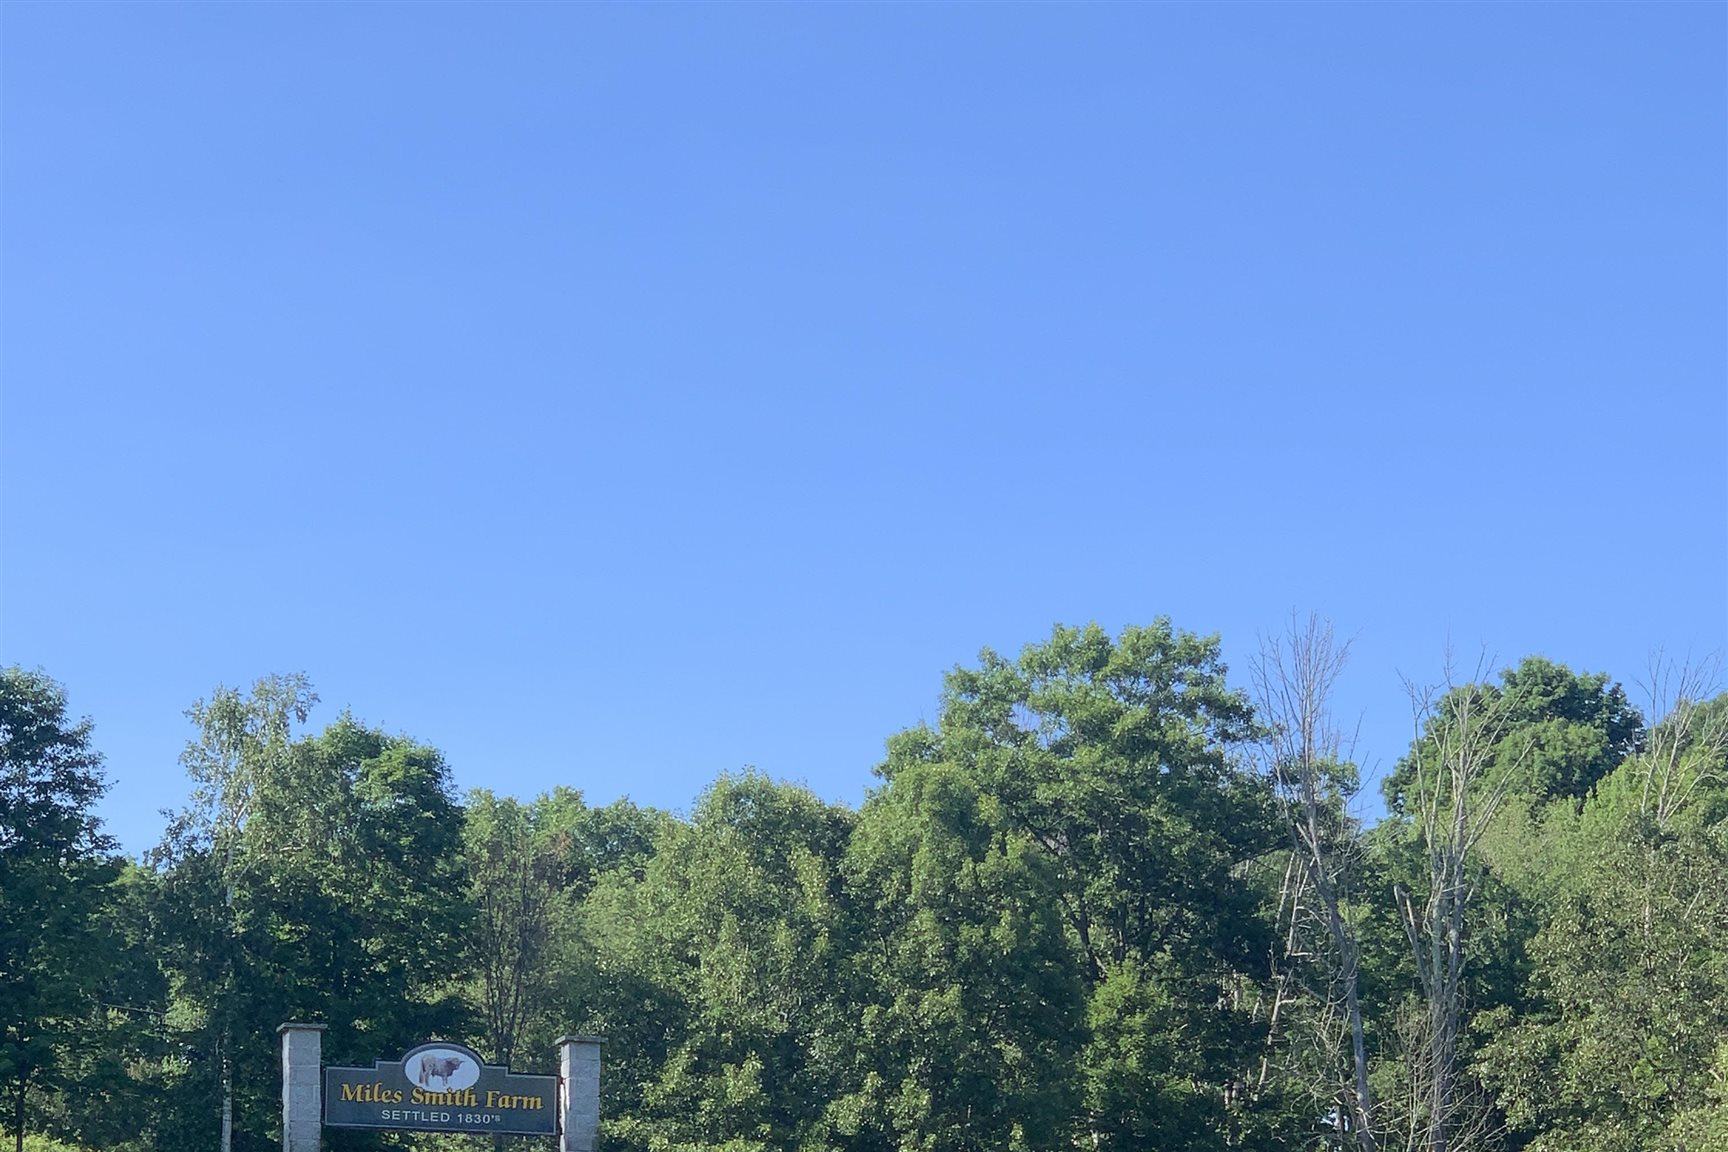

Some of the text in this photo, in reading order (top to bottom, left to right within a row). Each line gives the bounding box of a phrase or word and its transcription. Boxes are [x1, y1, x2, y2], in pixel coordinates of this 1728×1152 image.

[340, 1082, 543, 1110] Miles Smith Farm
[381, 1109, 450, 1122] SETTLED
